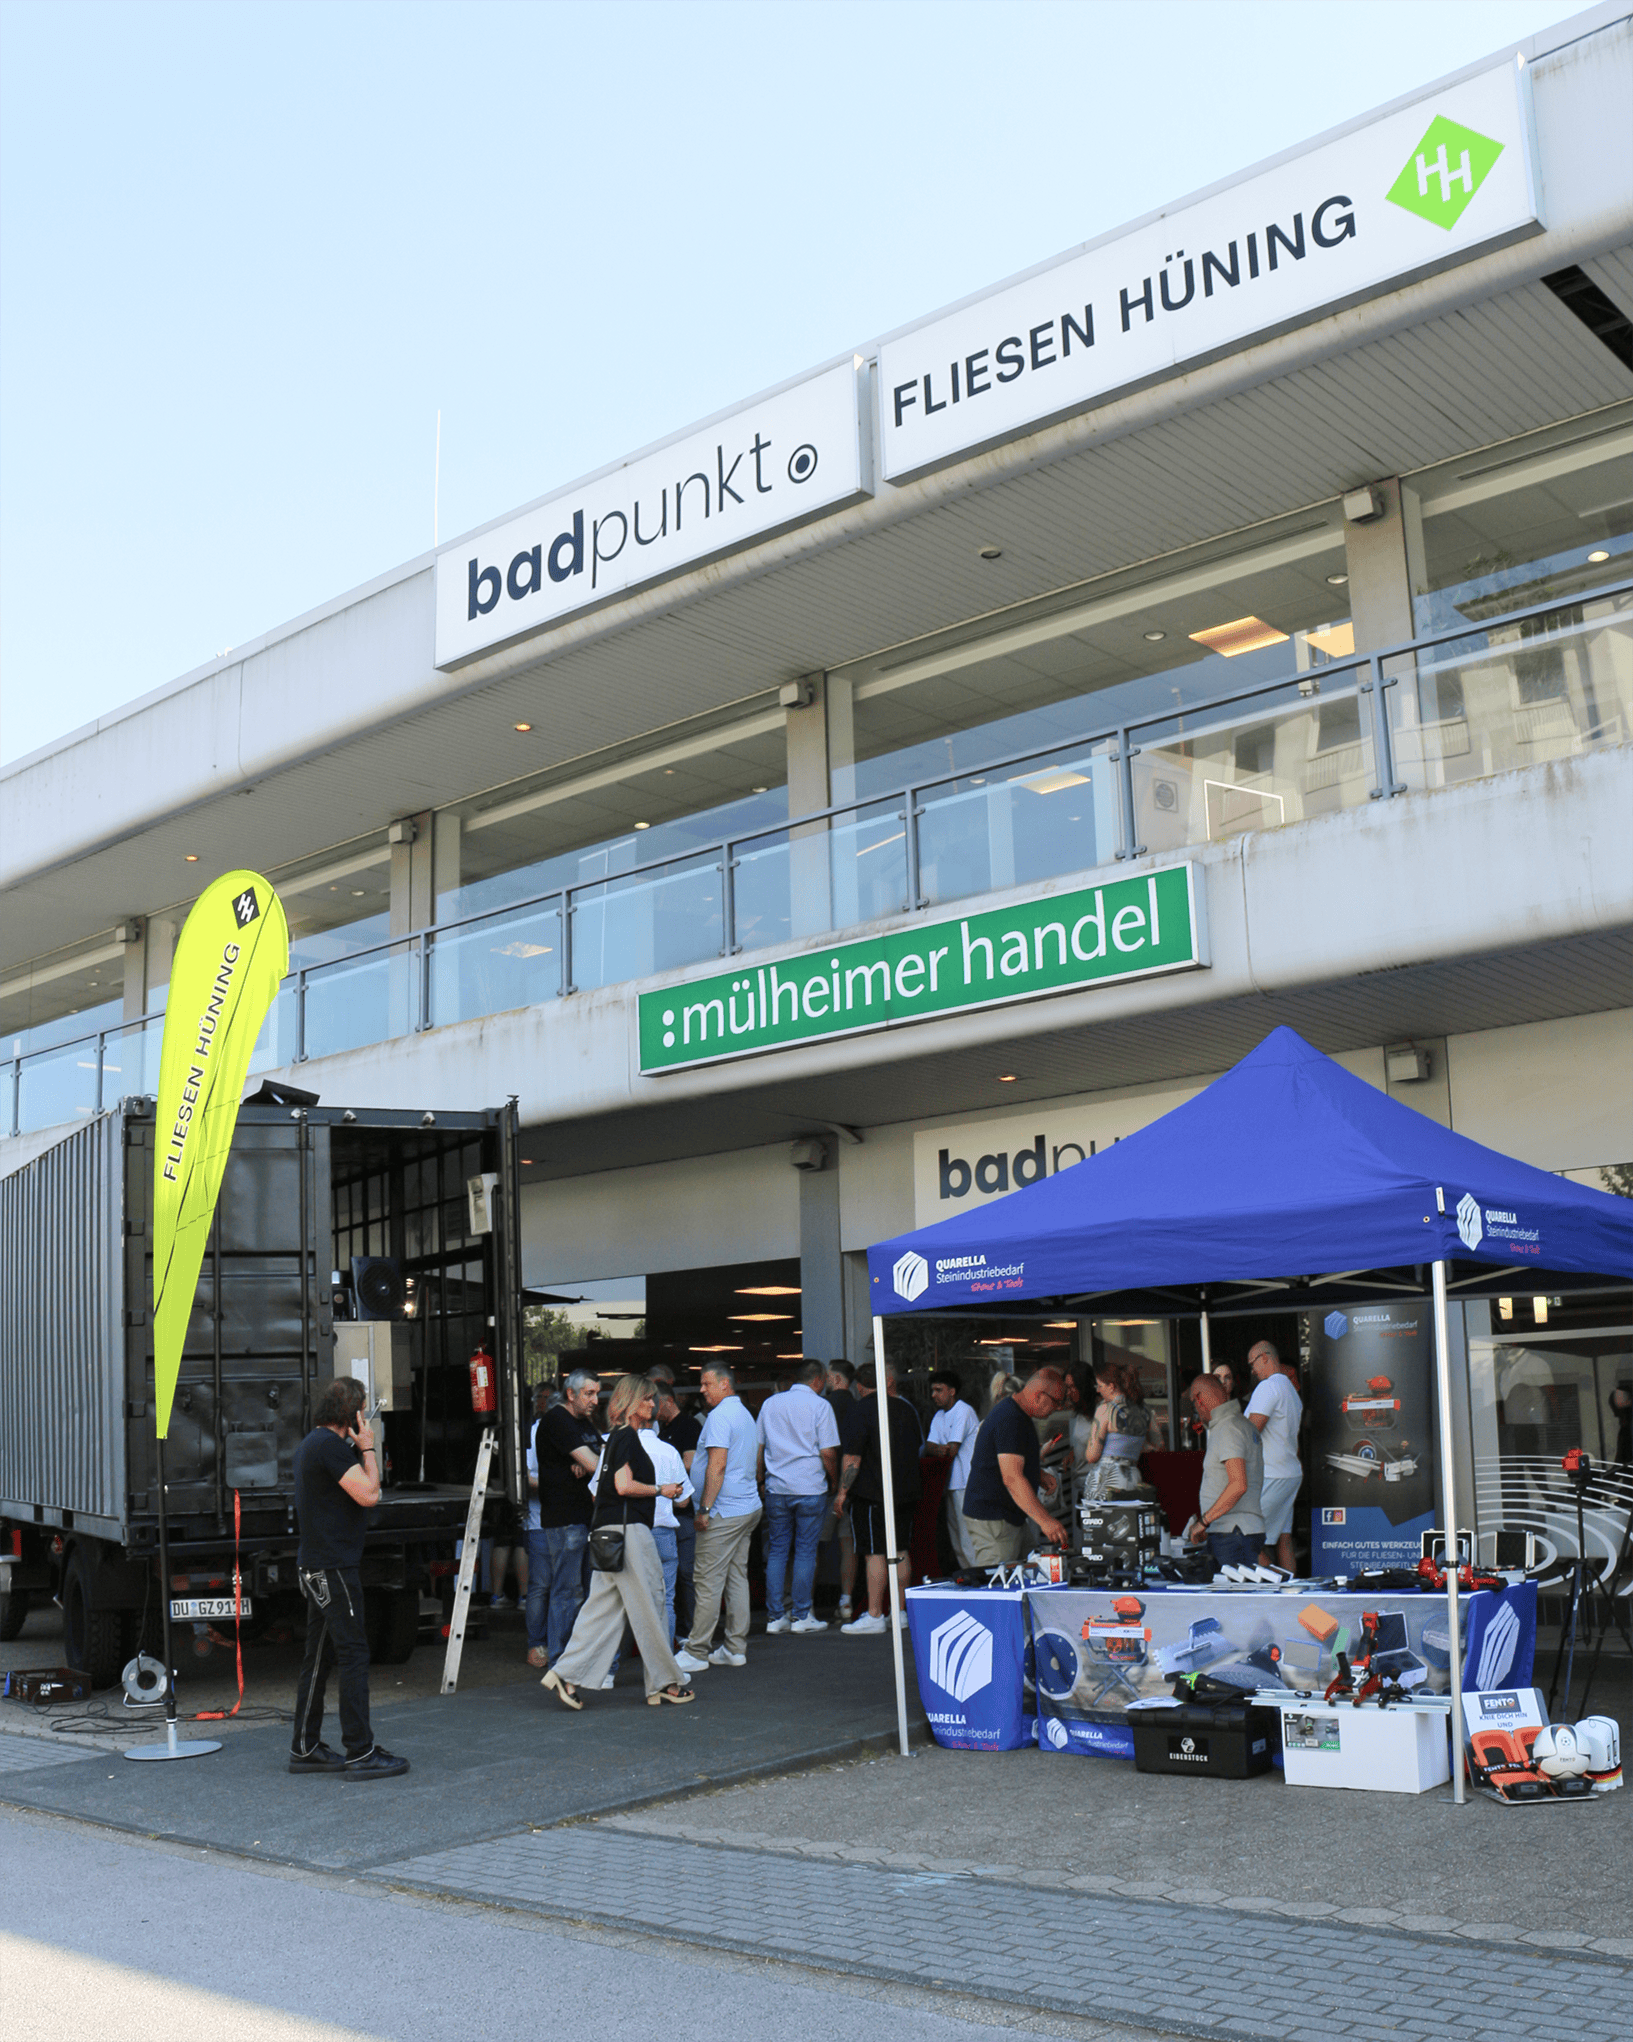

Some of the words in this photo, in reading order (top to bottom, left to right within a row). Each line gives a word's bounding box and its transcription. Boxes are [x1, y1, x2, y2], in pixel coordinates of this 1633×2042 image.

[893, 303, 1096, 427] FLIESEN
[1119, 194, 1358, 332] HÜNING
[467, 433, 773, 621] badpunkt
[960, 877, 1160, 984] handel
[195, 943, 241, 1056] HÜNING
[163, 1066, 204, 1182] FLIESEN
[1485, 1210, 1517, 1224] QUARELLA
[935, 1254, 987, 1273] QUARELLA
[936, 1262, 1025, 1284] Steinindustriebedarf
[1352, 1314, 1391, 1325] QUARELLA
[1322, 1541, 1354, 1550] EINFACH
[1354, 1541, 1381, 1549] GUTES
[1341, 1550, 1357, 1560] FÜR
[1358, 1551, 1371, 1559] DIE
[1371, 1551, 1406, 1560] FLIESEN-
[173, 1602, 189, 1616] DU
[198, 1601, 215, 1615] GZ
[1484, 1697, 1515, 1709] FENTO
[926, 1712, 967, 1725] UARELLA
